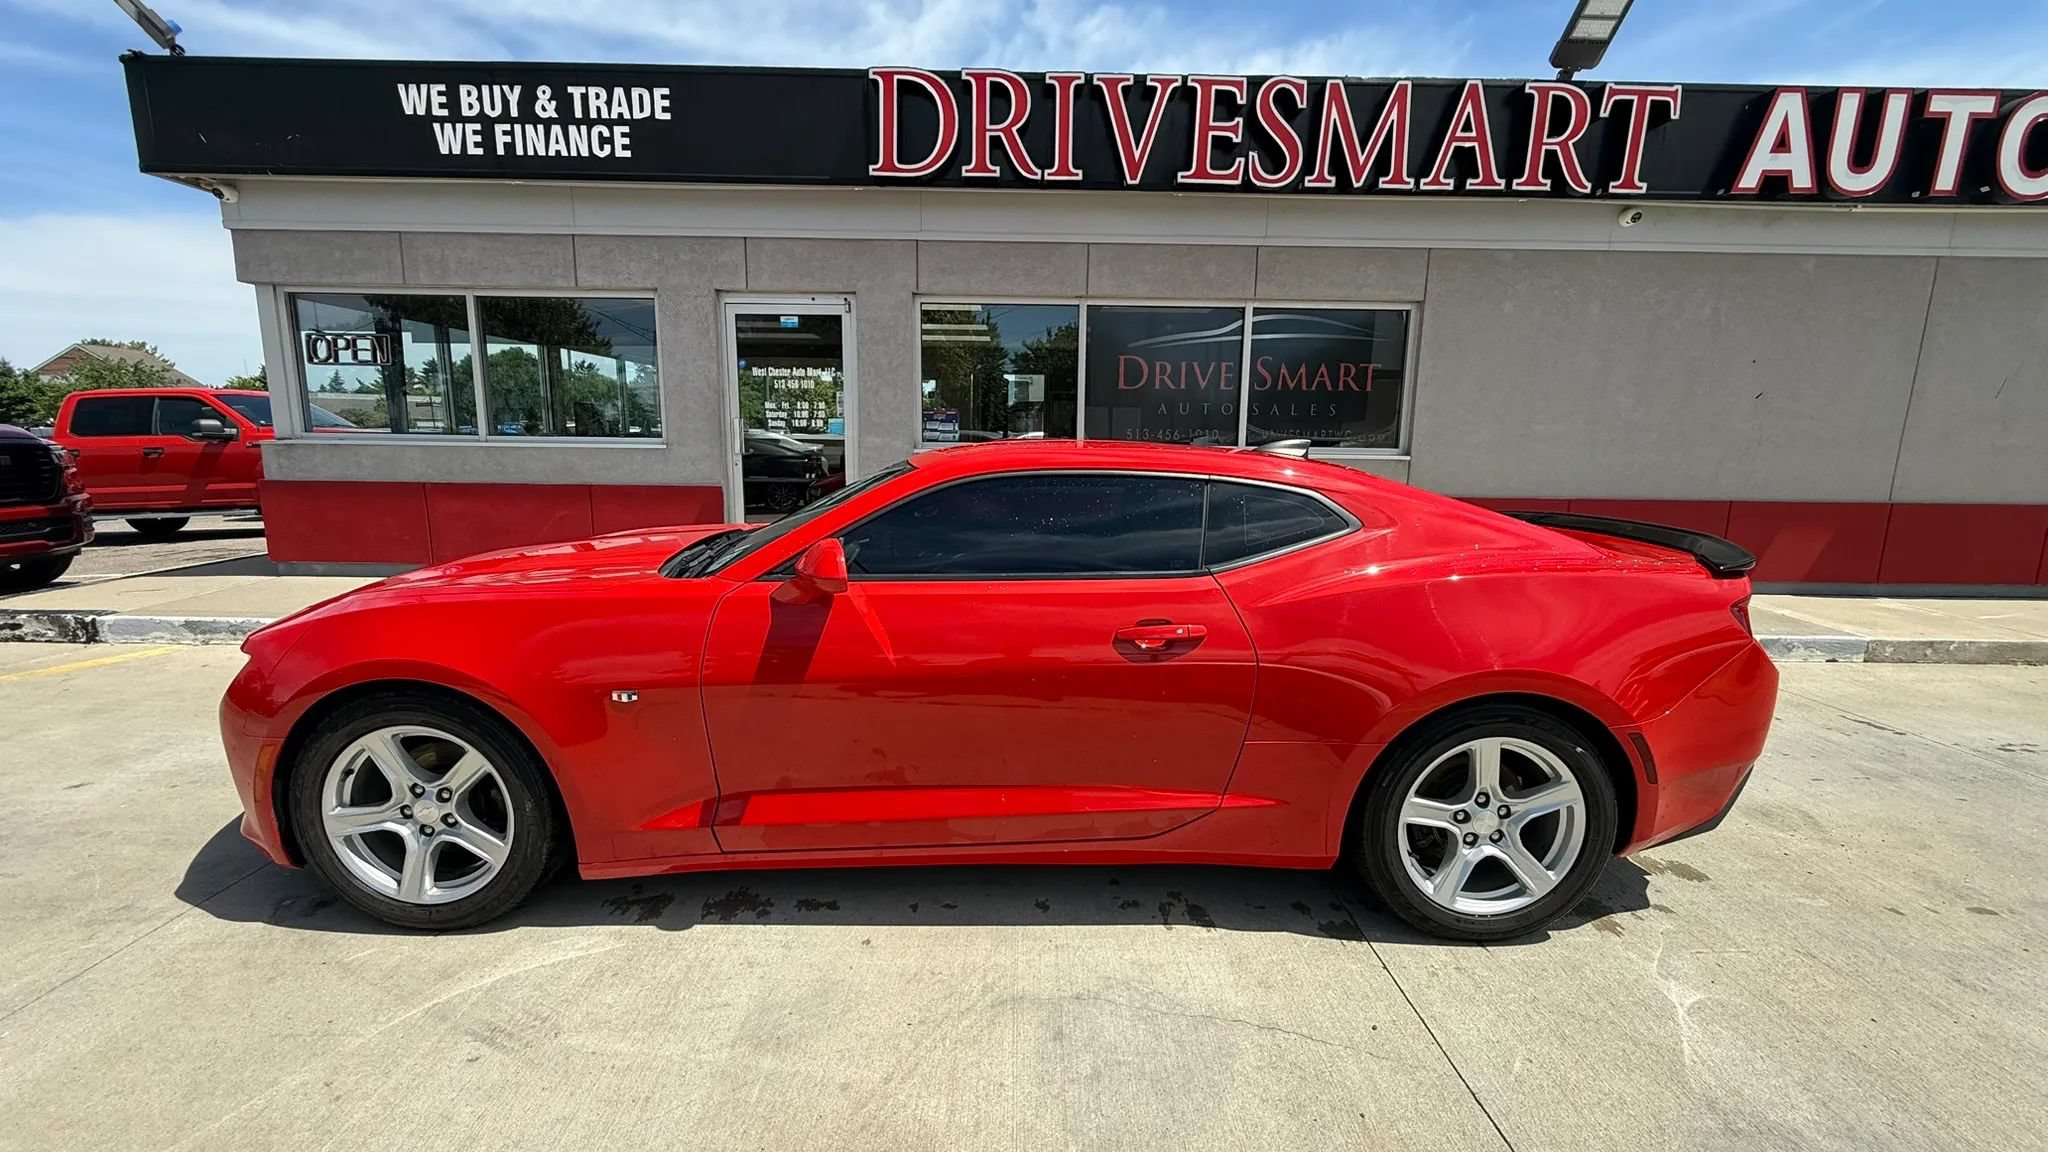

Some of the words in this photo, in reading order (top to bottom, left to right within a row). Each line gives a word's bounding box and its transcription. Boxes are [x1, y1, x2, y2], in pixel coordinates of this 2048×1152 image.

[397, 83, 449, 116] WE
[459, 84, 522, 118] BUY
[534, 84, 559, 118] &
[567, 85, 672, 120] TRADE
[432, 122, 484, 155] WE
[494, 123, 632, 158] FINANCE
[868, 67, 1682, 194] DRIVESMART
[309, 335, 389, 364] OPEN
[752, 367, 767, 376] West
[768, 367, 791, 377] Chester
[792, 367, 806, 376] Auto
[1158, 402, 1233, 416] AUTO
[1252, 402, 1337, 417] SALES
